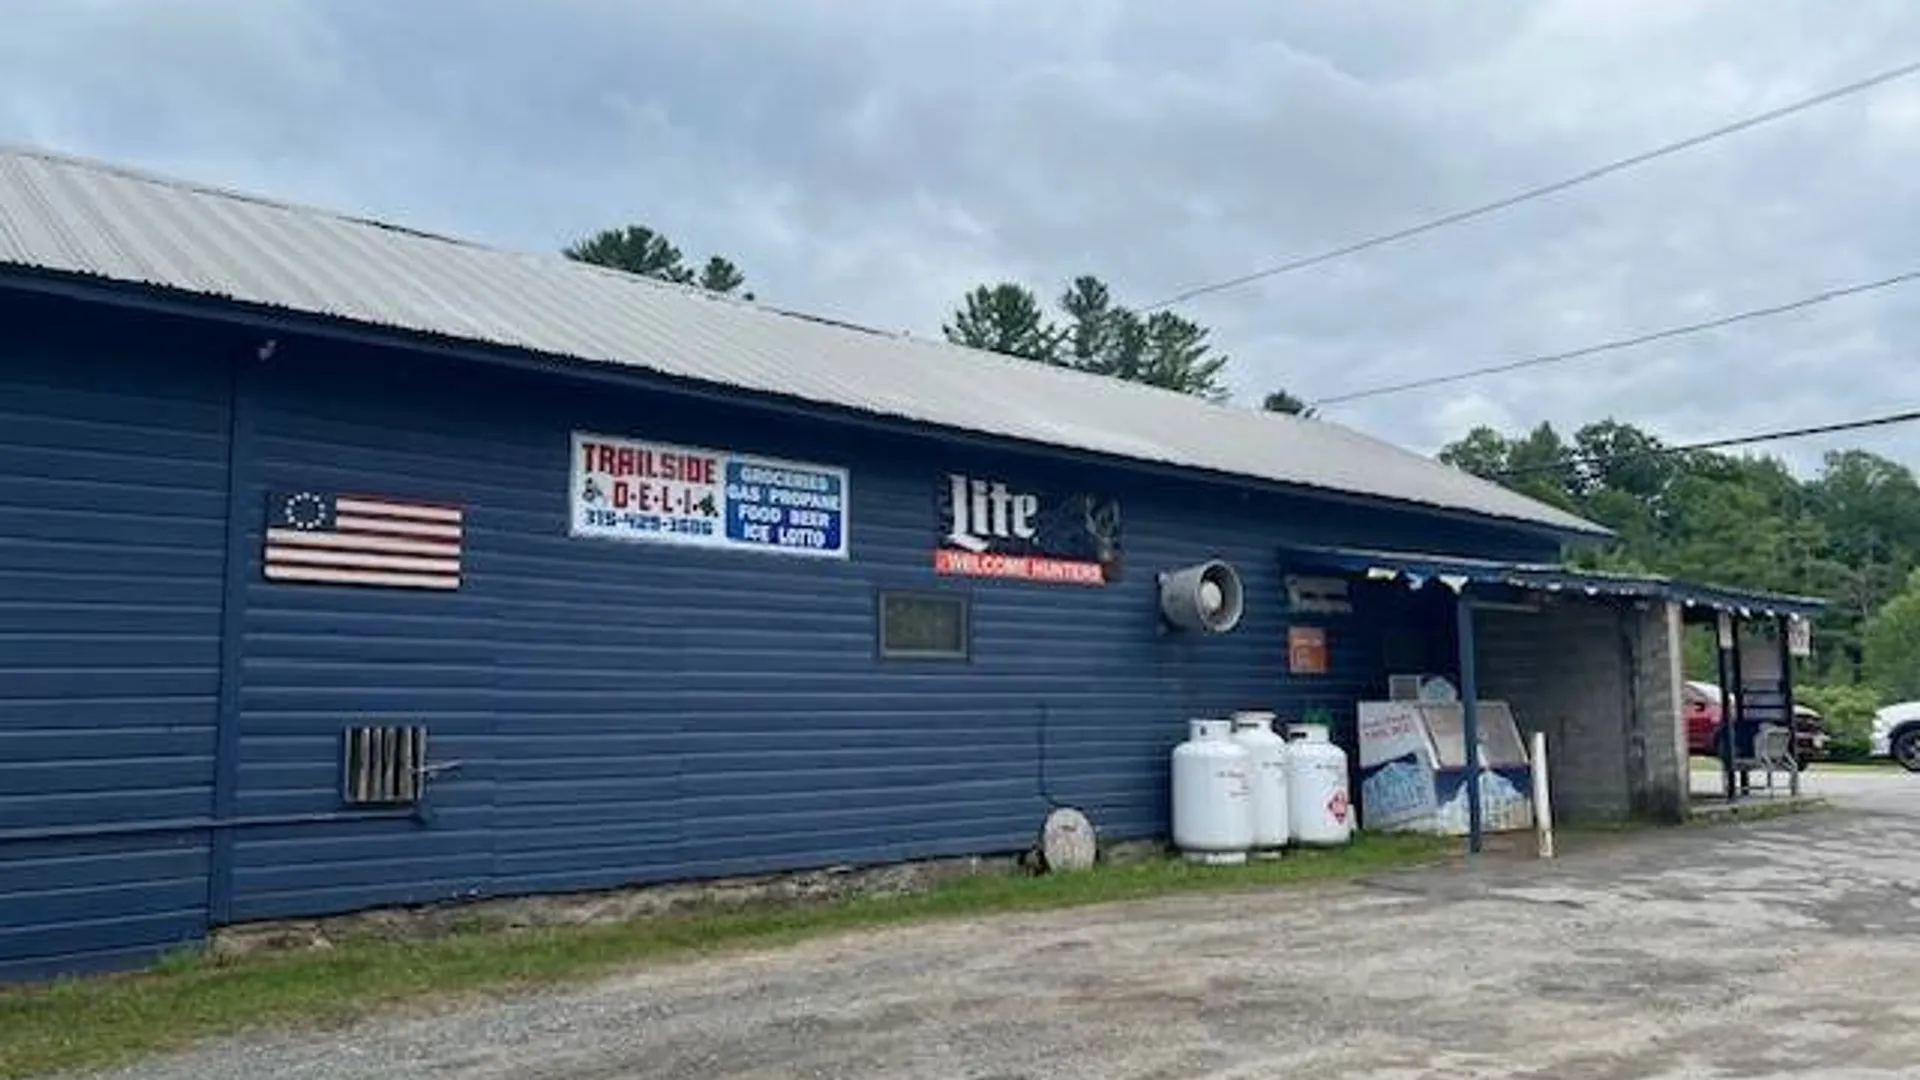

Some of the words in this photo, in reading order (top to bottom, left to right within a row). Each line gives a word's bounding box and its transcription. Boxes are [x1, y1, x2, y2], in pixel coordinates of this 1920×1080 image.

[582, 443, 717, 485] TRAILSIDE
[740, 466, 829, 492] GROCERIES
[727, 483, 760, 502] GAS
[769, 488, 840, 512] PROPANE
[738, 502, 781, 524] FOOD
[789, 509, 829, 530] BEER
[949, 474, 1038, 552] Lite
[743, 521, 770, 542] ICE
[779, 526, 826, 548] LOTTO
[949, 552, 1030, 576] WELCOME
[1032, 560, 1098, 581] HUNTERS
